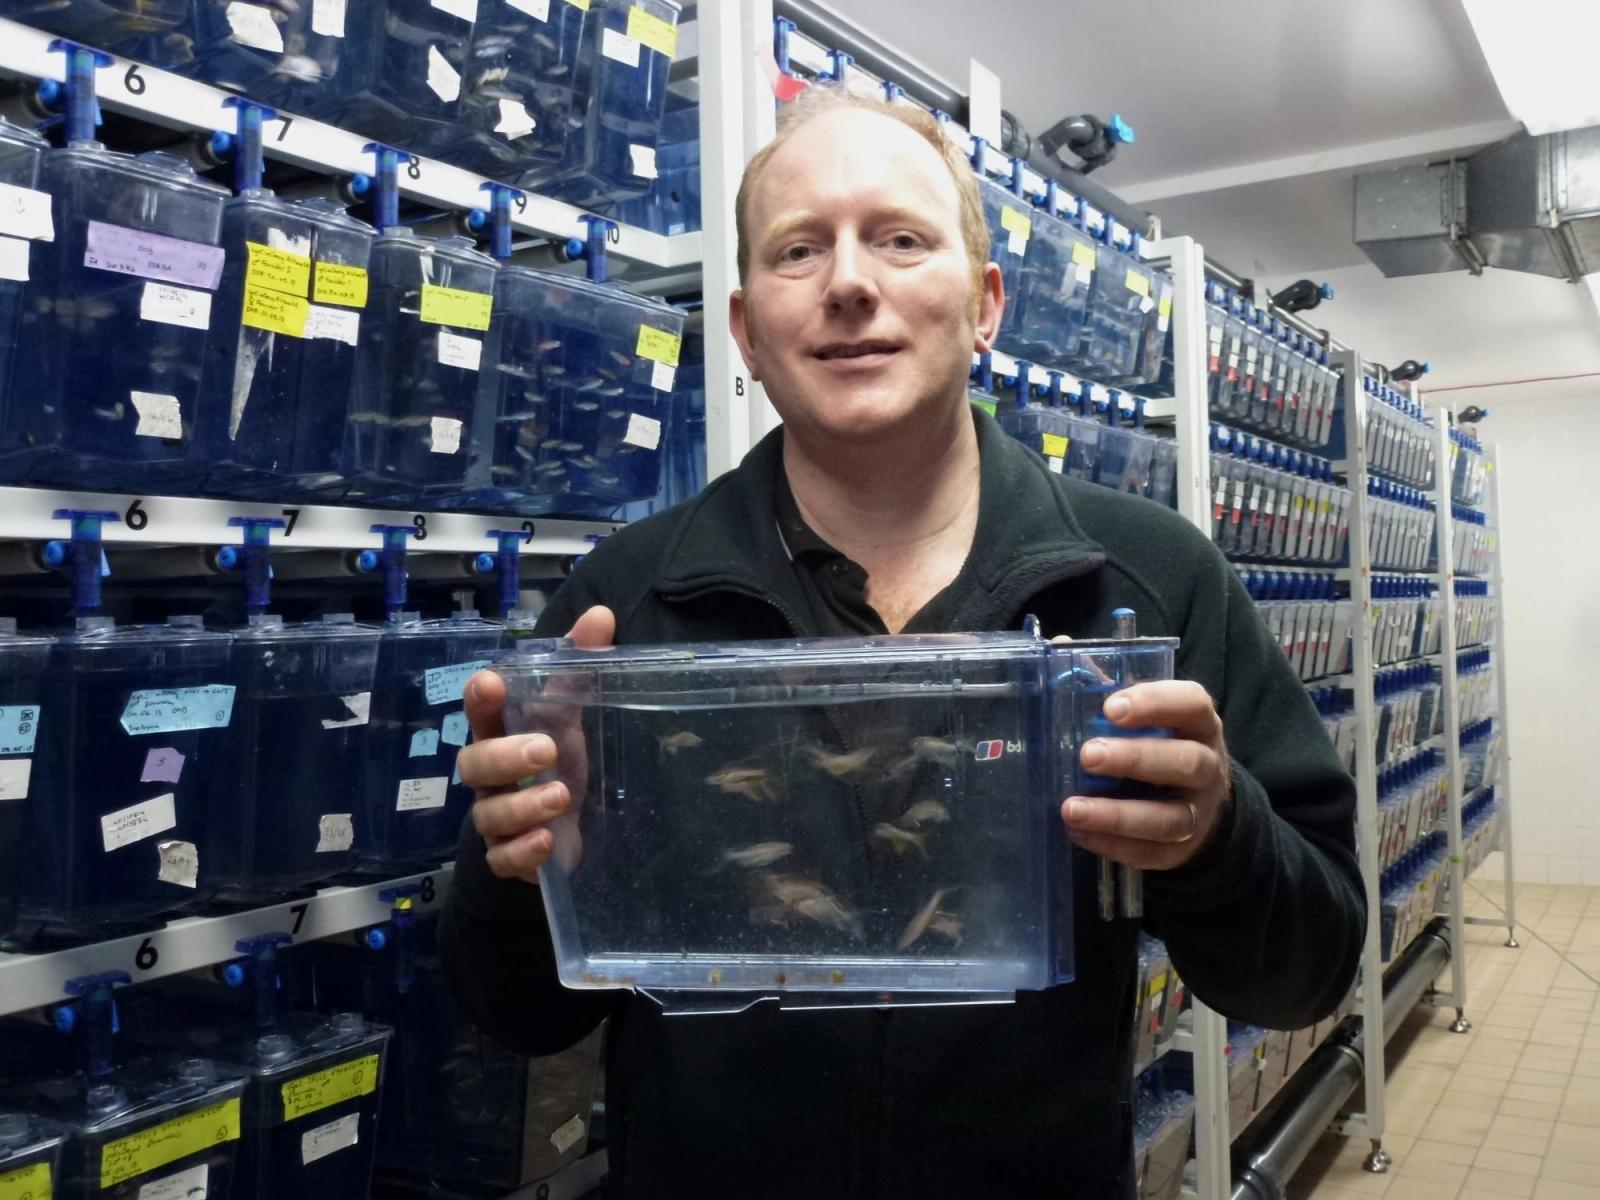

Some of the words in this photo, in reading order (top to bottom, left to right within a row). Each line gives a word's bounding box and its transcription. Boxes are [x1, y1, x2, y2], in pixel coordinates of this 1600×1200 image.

[124, 64, 146, 95] 6
[276, 118, 293, 141] 7
[407, 156, 420, 180] 8
[514, 191, 527, 214] 9
[606, 224, 620, 244] 10
[735, 376, 744, 396] B
[125, 500, 148, 530] 6
[282, 509, 300, 537] 7
[289, 904, 308, 934] 7
[135, 937, 158, 970] 6
